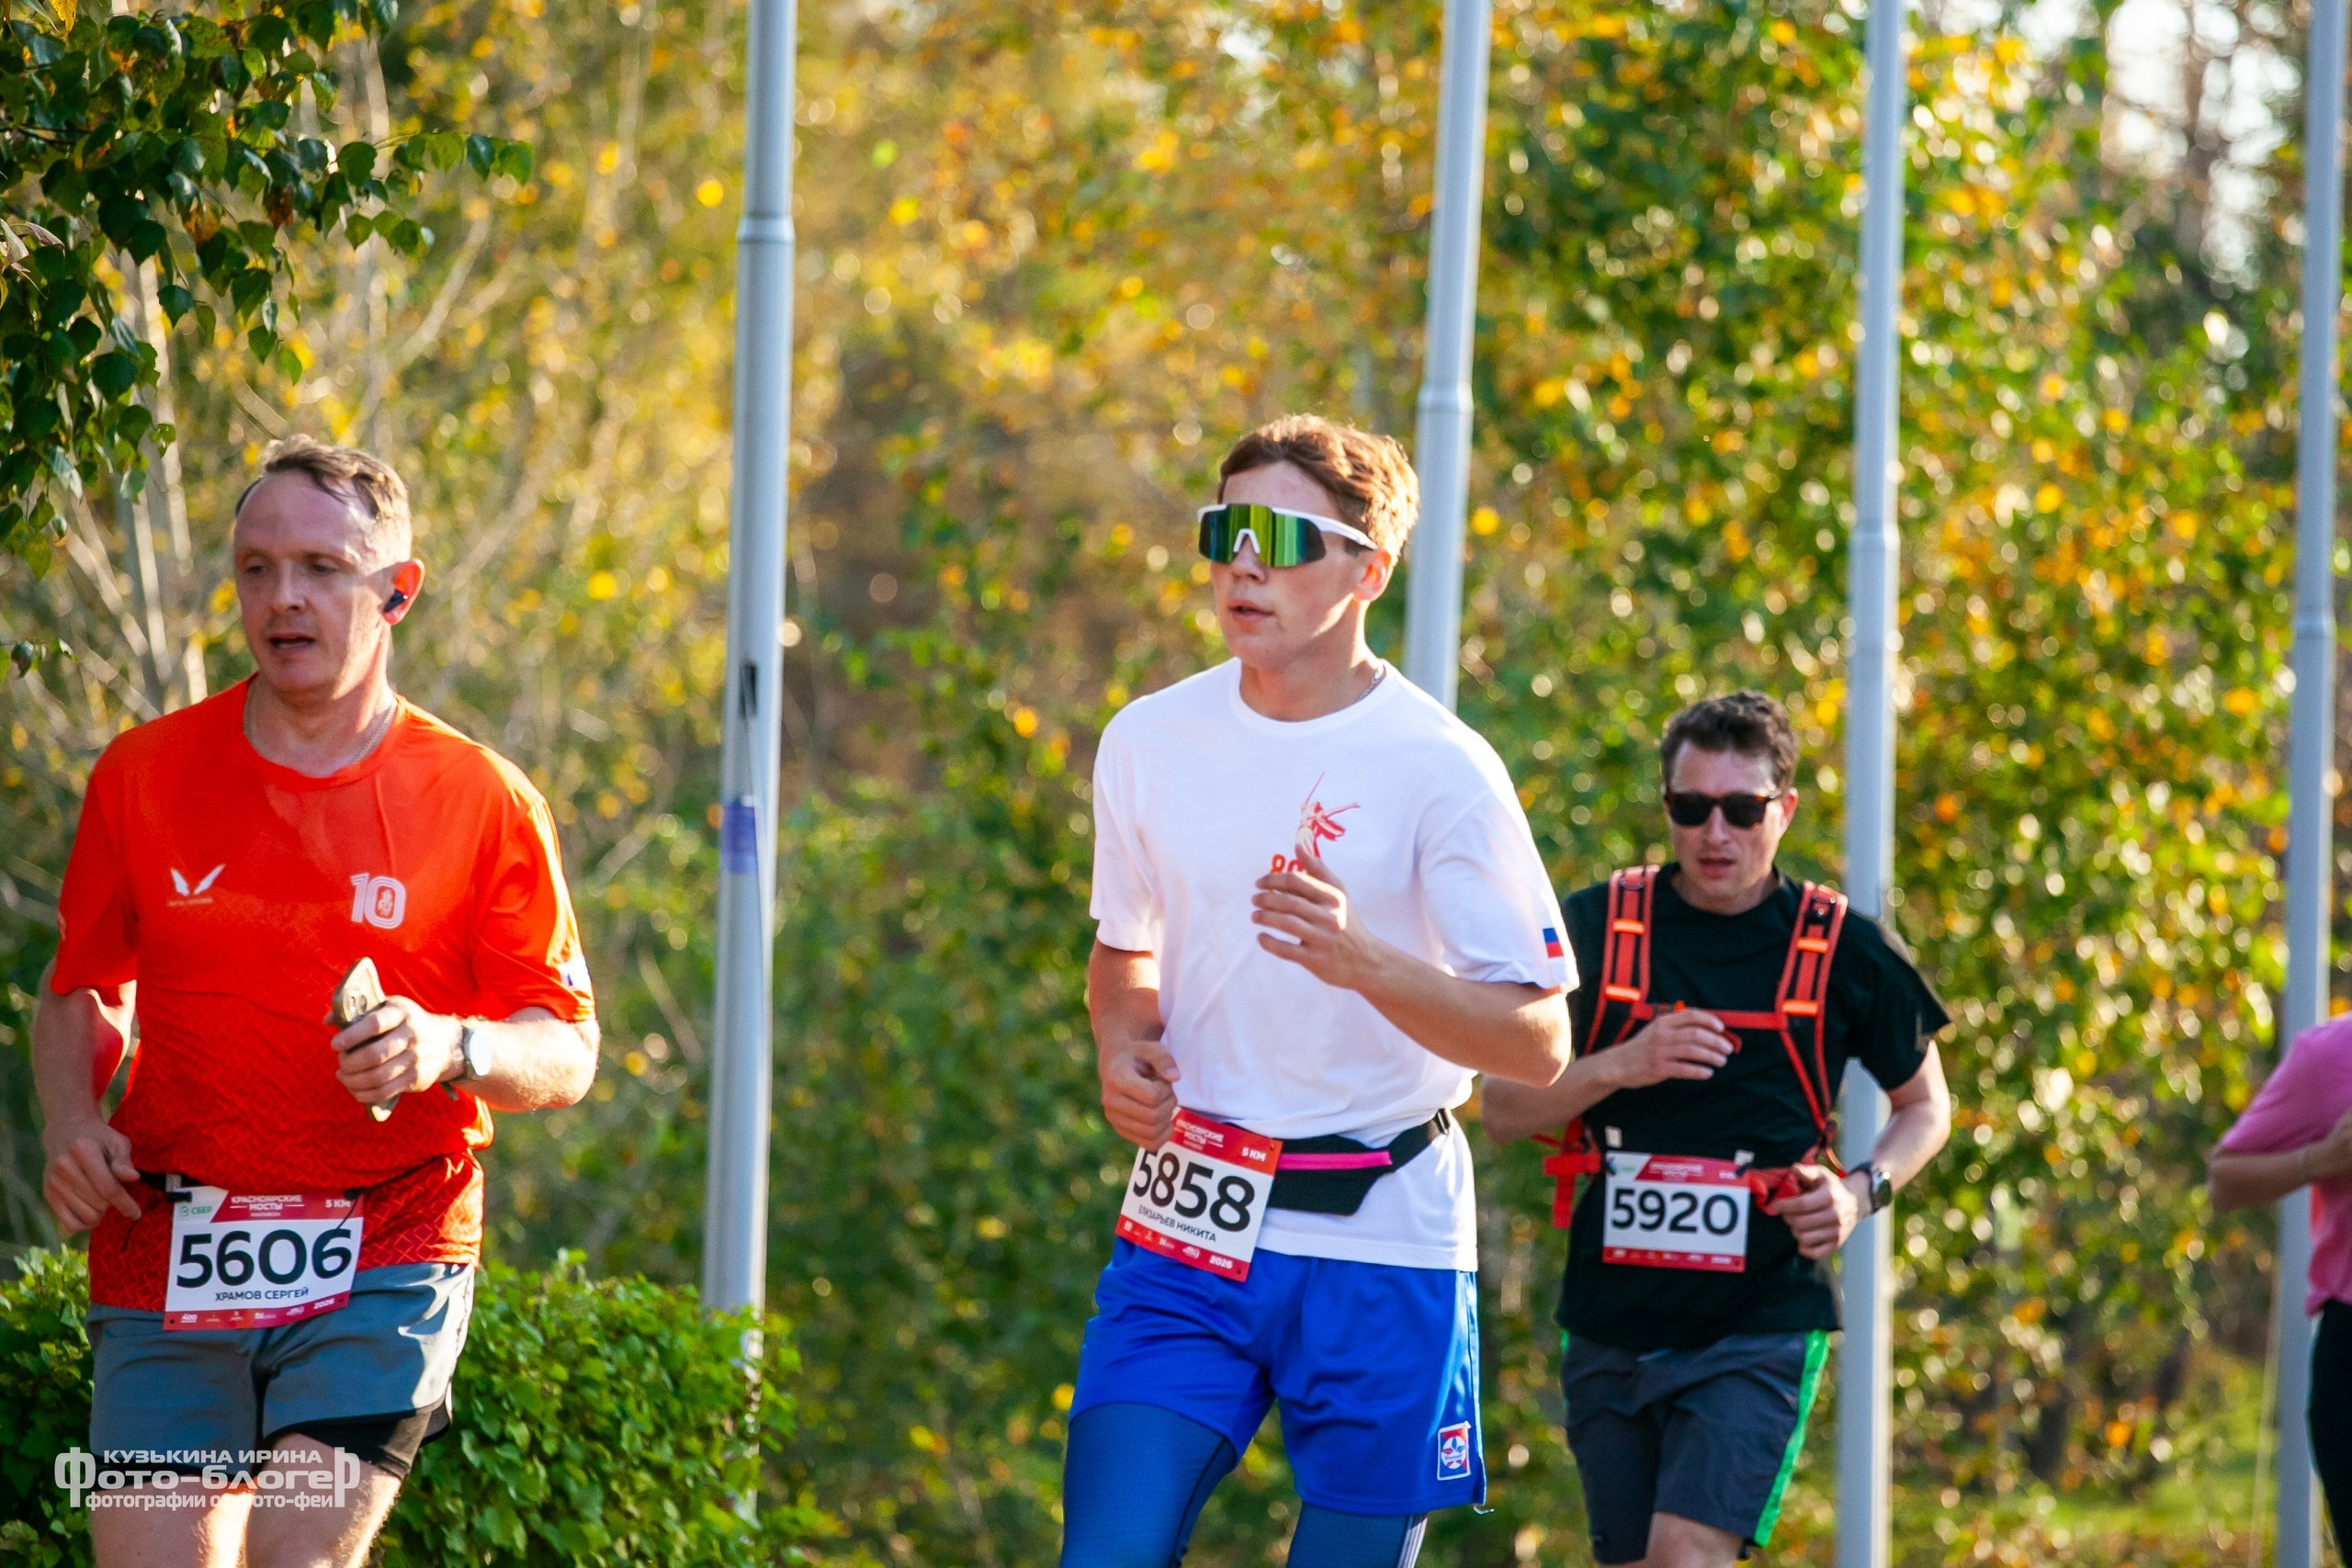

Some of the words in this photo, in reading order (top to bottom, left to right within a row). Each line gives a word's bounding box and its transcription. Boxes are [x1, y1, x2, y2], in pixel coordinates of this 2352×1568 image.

[350, 873, 406, 930] 10
[1133, 1151, 1255, 1232] 5858
[1611, 1188, 1738, 1235] 5920
[1138, 1205, 1175, 1228] ЕЛИЗАРЬЕВ
[1176, 1222, 1216, 1242] НИКИТА
[176, 1229, 352, 1289] 5606
[215, 1291, 262, 1302] ХРАМОВ
[265, 1287, 309, 1300] СЕРГЕЙ
